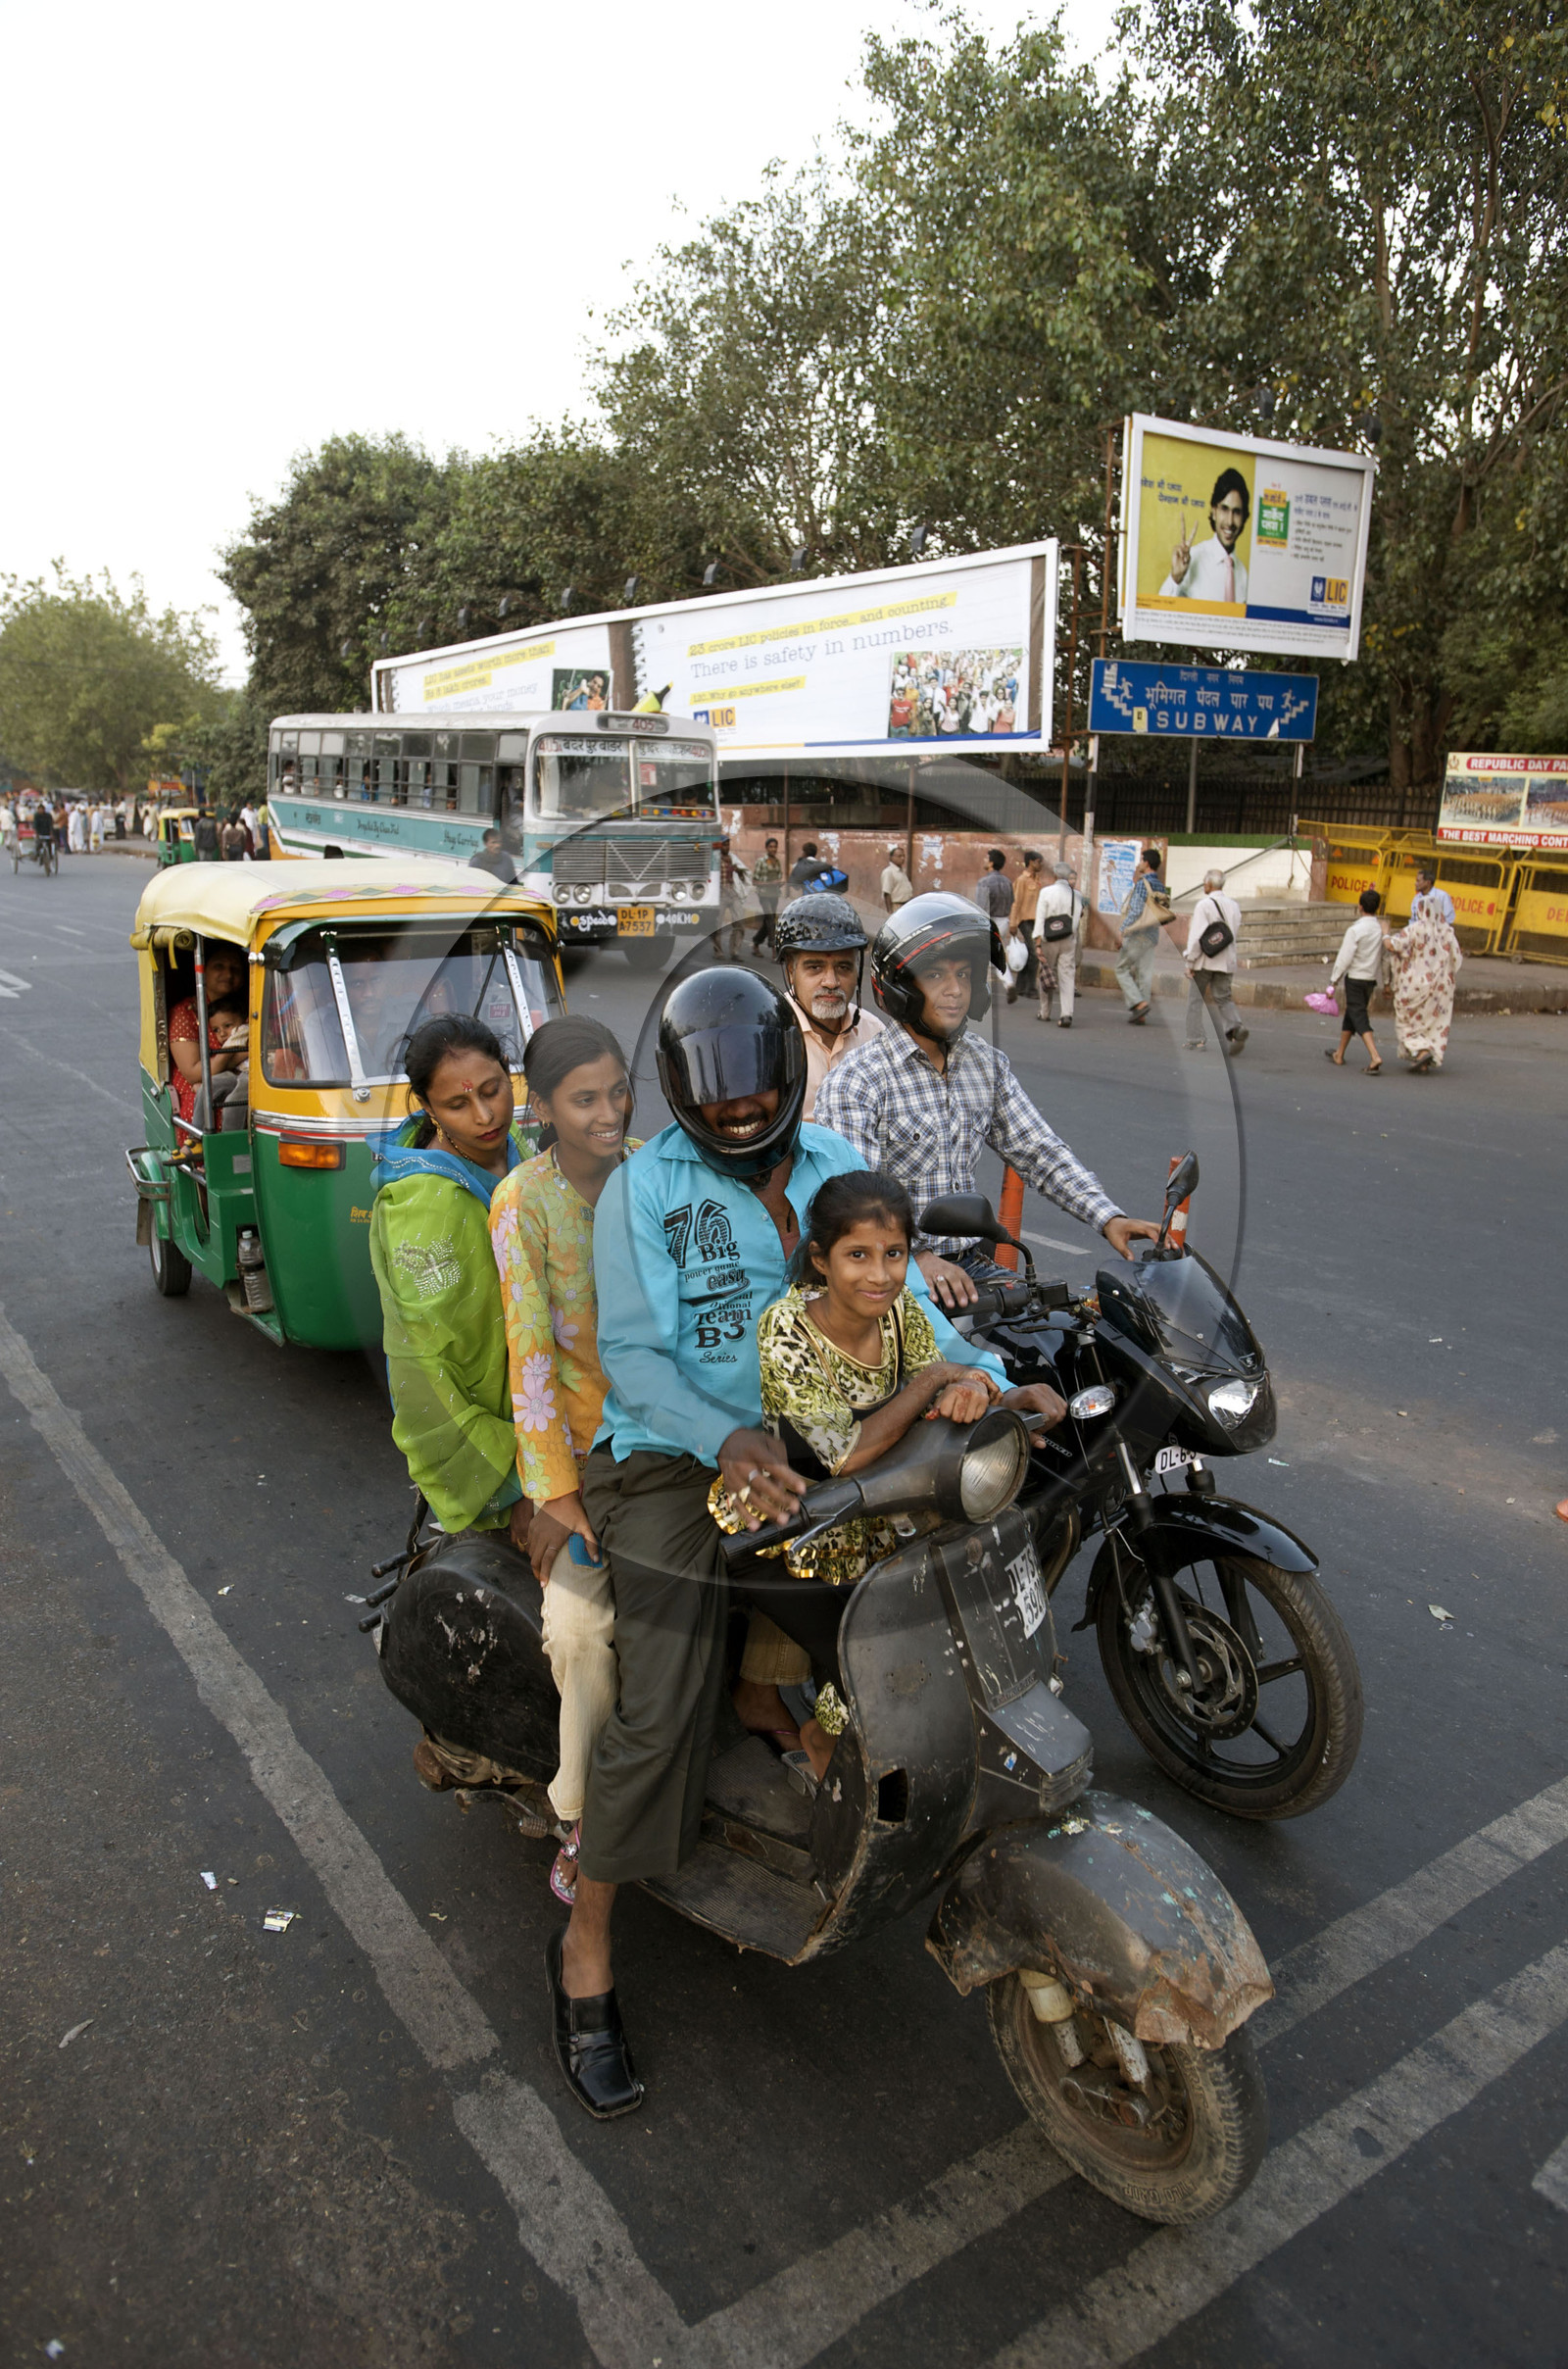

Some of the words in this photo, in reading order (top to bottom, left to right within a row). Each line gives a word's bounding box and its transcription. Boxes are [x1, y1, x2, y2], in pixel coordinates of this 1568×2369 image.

[1327, 581, 1347, 602] LIC
[690, 643, 705, 657] 23
[709, 640, 735, 653] crore
[739, 635, 757, 647] LIC
[760, 628, 800, 644] policies
[804, 623, 814, 635] in
[860, 611, 882, 622] and
[504, 651, 526, 663] more
[691, 661, 738, 678] There
[745, 655, 758, 669] is
[764, 643, 816, 666] safety
[825, 639, 844, 655] in
[854, 620, 953, 650] numbers.
[739, 684, 778, 696] anywhere
[1146, 680, 1186, 710] भूमिगत
[1230, 693, 1249, 710] पार
[633, 718, 655, 730] 405
[711, 709, 734, 727] LIC
[1156, 711, 1257, 733] SUBWAY
[1470, 758, 1525, 770] REPUBLIC
[1528, 759, 1550, 770] DAY
[1552, 761, 1568, 771] PA
[1443, 829, 1460, 840] THE
[1462, 830, 1488, 842] BEST
[1488, 833, 1539, 846] MARCHING
[1331, 874, 1368, 894] POLICE
[663, 1199, 731, 1268] 76
[698, 1239, 741, 1263] Big
[684, 1266, 711, 1282] power
[714, 1260, 740, 1273] game
[707, 1268, 746, 1291] easy
[694, 1308, 753, 1326] Team
[695, 1319, 746, 1349] B3
[699, 1351, 738, 1364] Series
